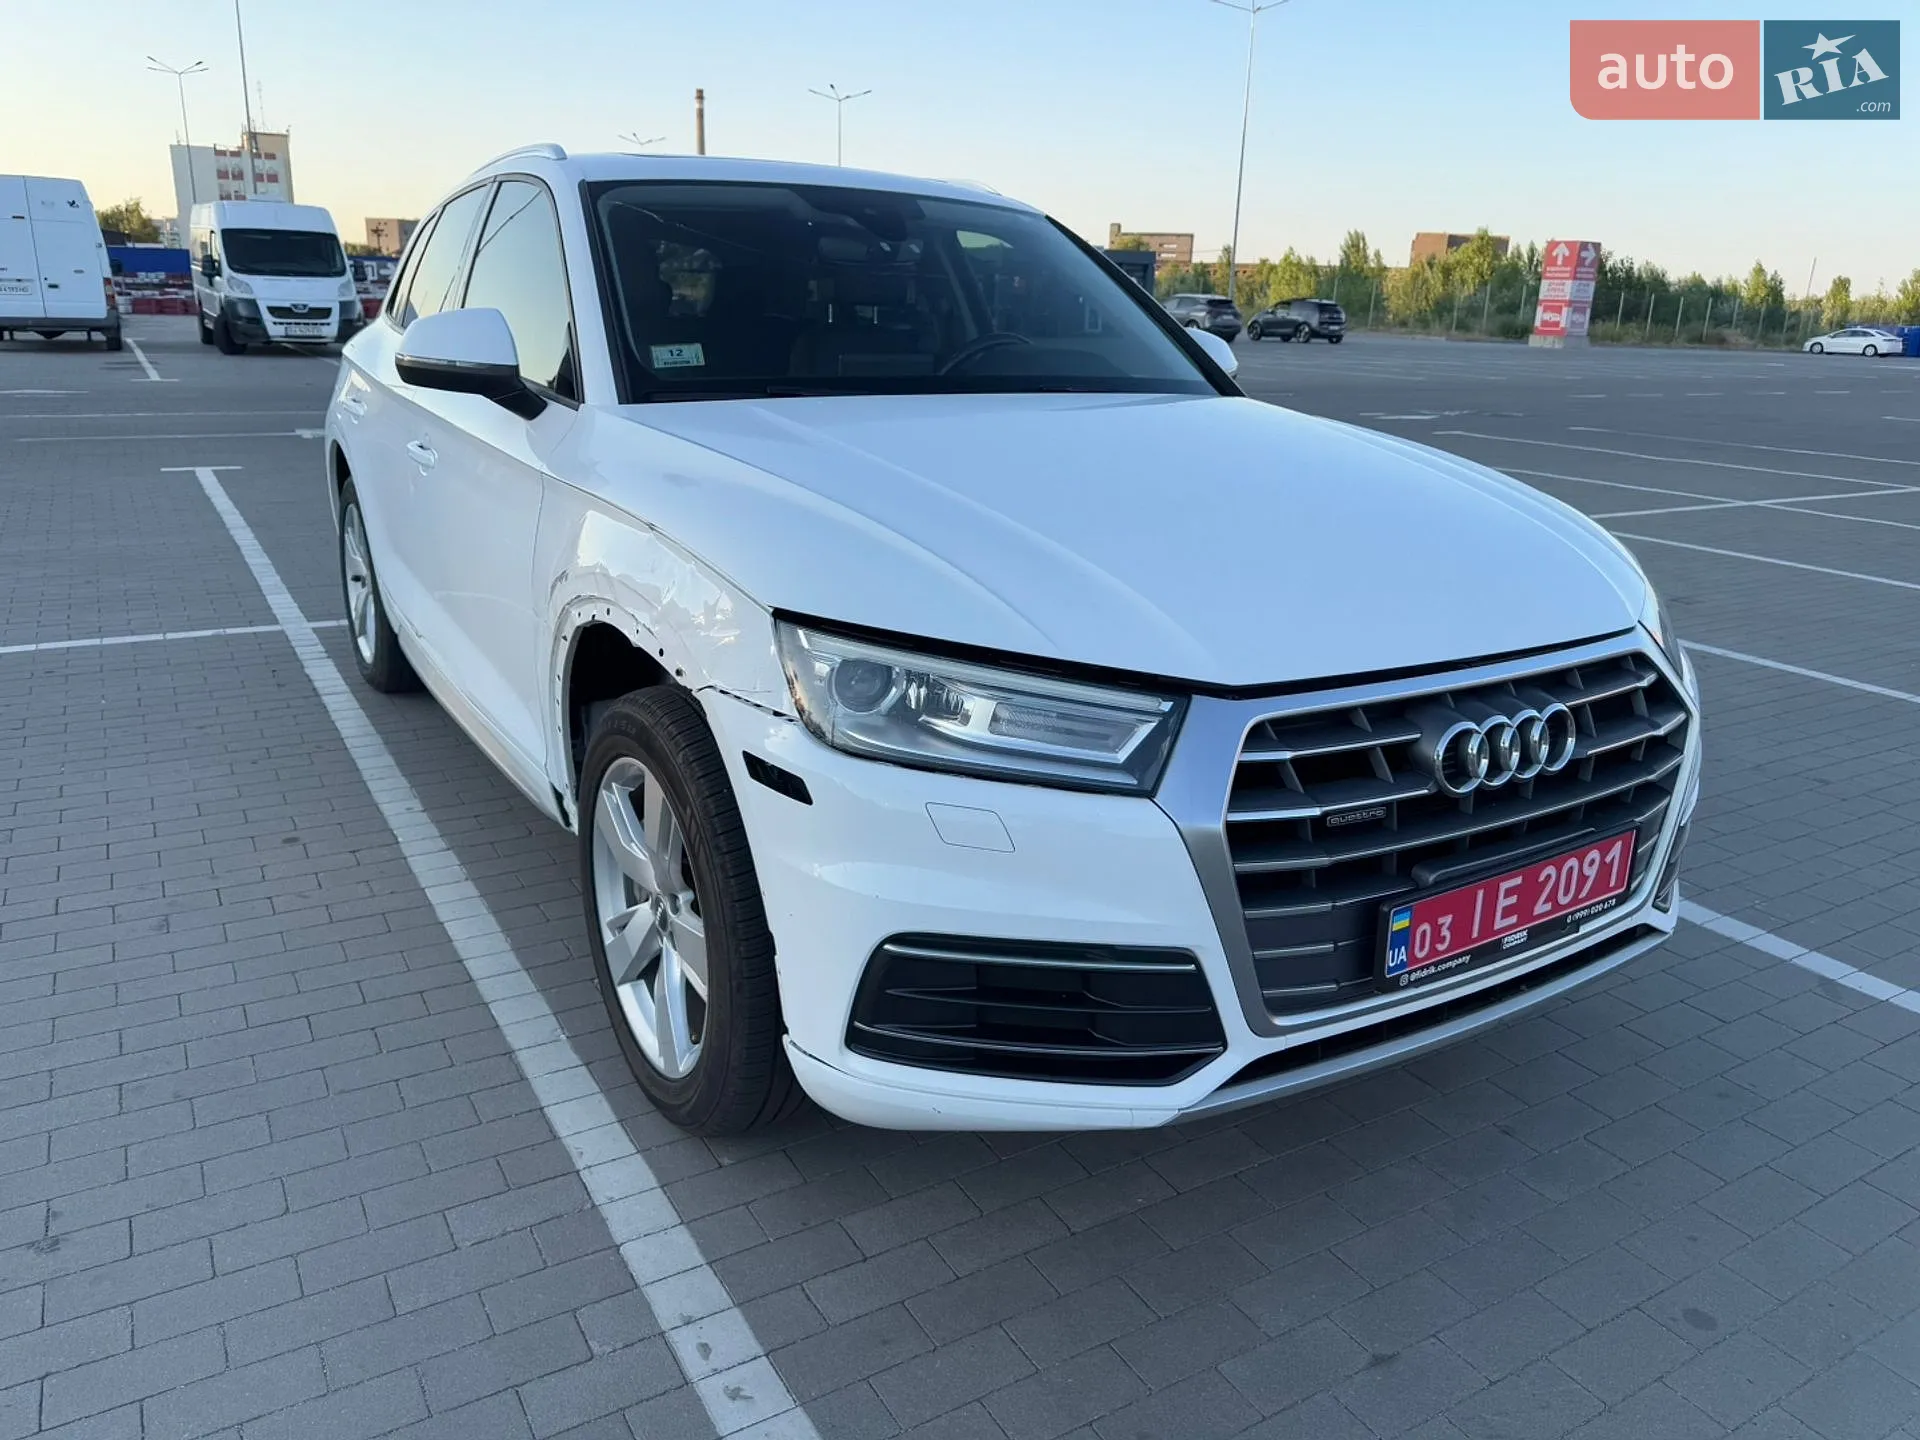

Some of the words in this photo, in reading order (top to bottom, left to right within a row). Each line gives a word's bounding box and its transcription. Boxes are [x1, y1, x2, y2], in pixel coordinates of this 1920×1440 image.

[669, 349, 684, 357] 12
[1414, 914, 1454, 959] 03
[1471, 875, 1523, 939] IE
[1532, 839, 1624, 916] 2091
[1388, 946, 1408, 968] UA
